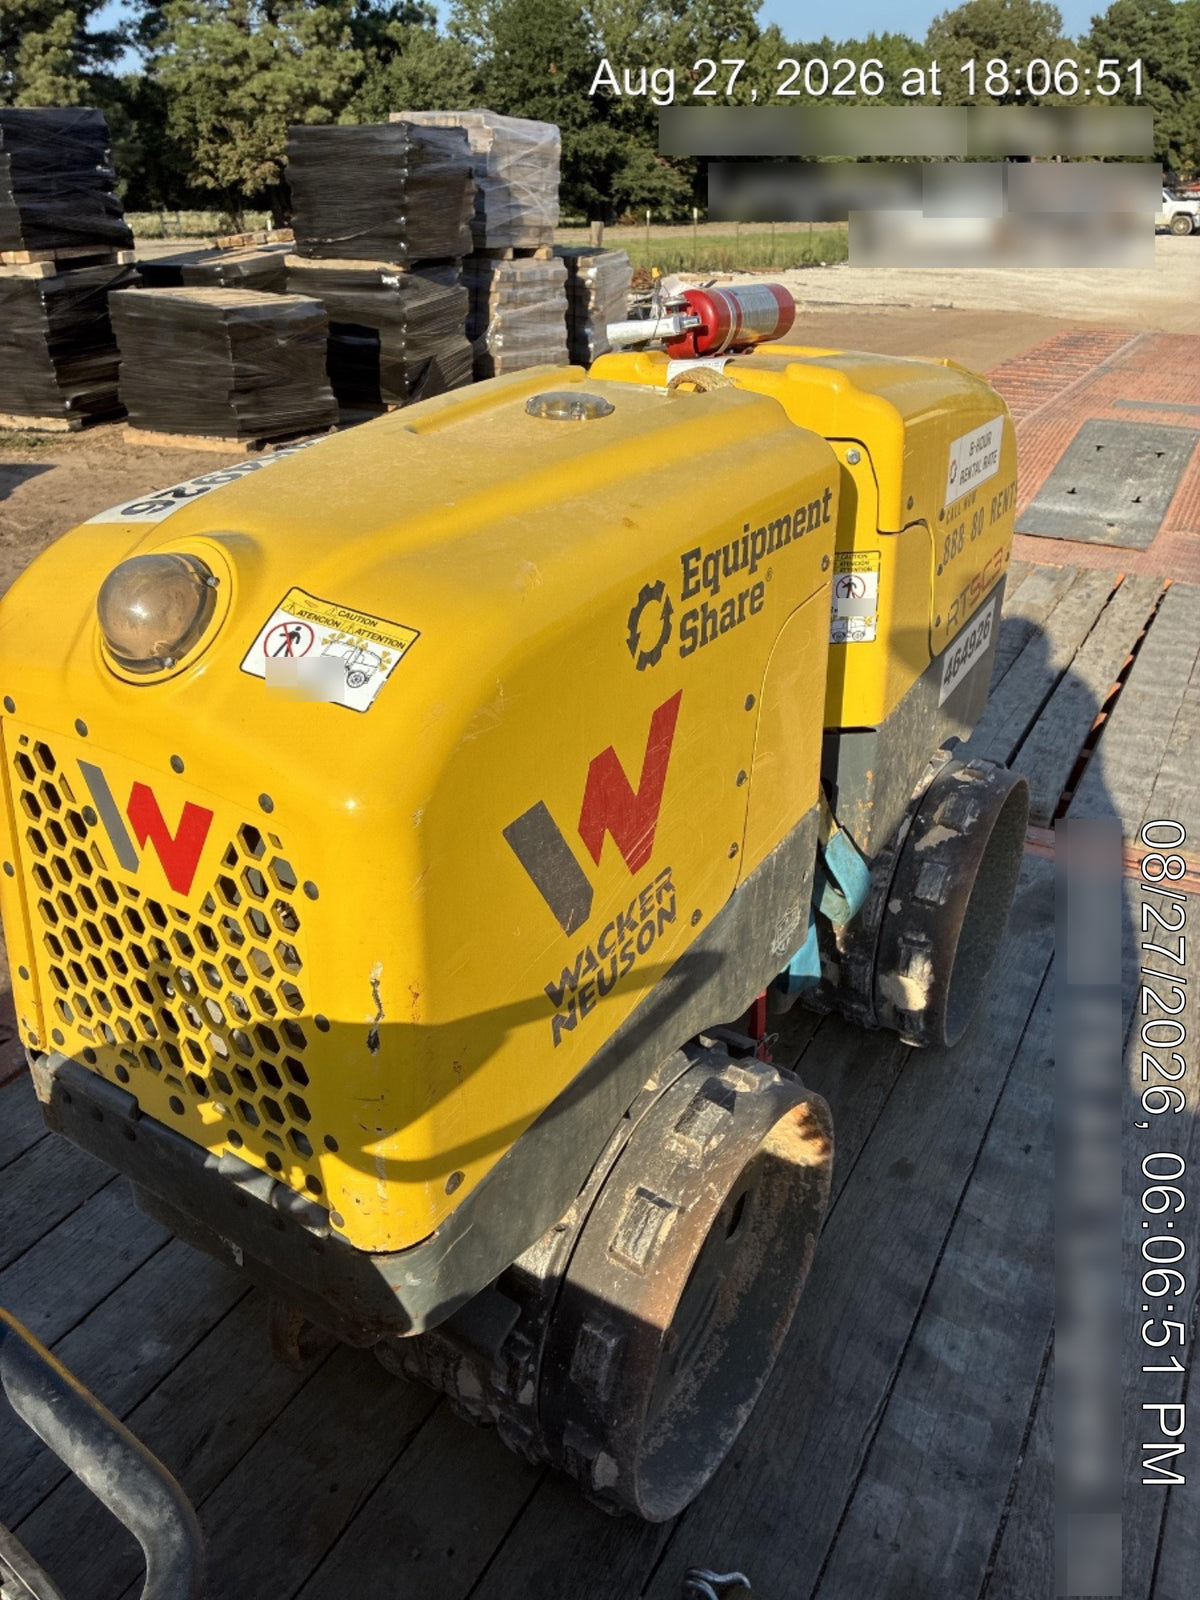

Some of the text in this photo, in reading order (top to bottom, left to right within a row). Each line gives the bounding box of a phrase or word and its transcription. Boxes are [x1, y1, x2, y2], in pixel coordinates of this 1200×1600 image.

[959, 448, 999, 485] RENTAL RATE
[680, 487, 833, 602] Equipment
[943, 522, 965, 566] 888
[971, 506, 985, 542] 80
[296, 609, 407, 650] ATENCION ATTENTION
[337, 610, 378, 628] CAUTION
[942, 610, 992, 687] 464926
[543, 866, 676, 1009] WACKER
[551, 894, 677, 1049] NEUSON
